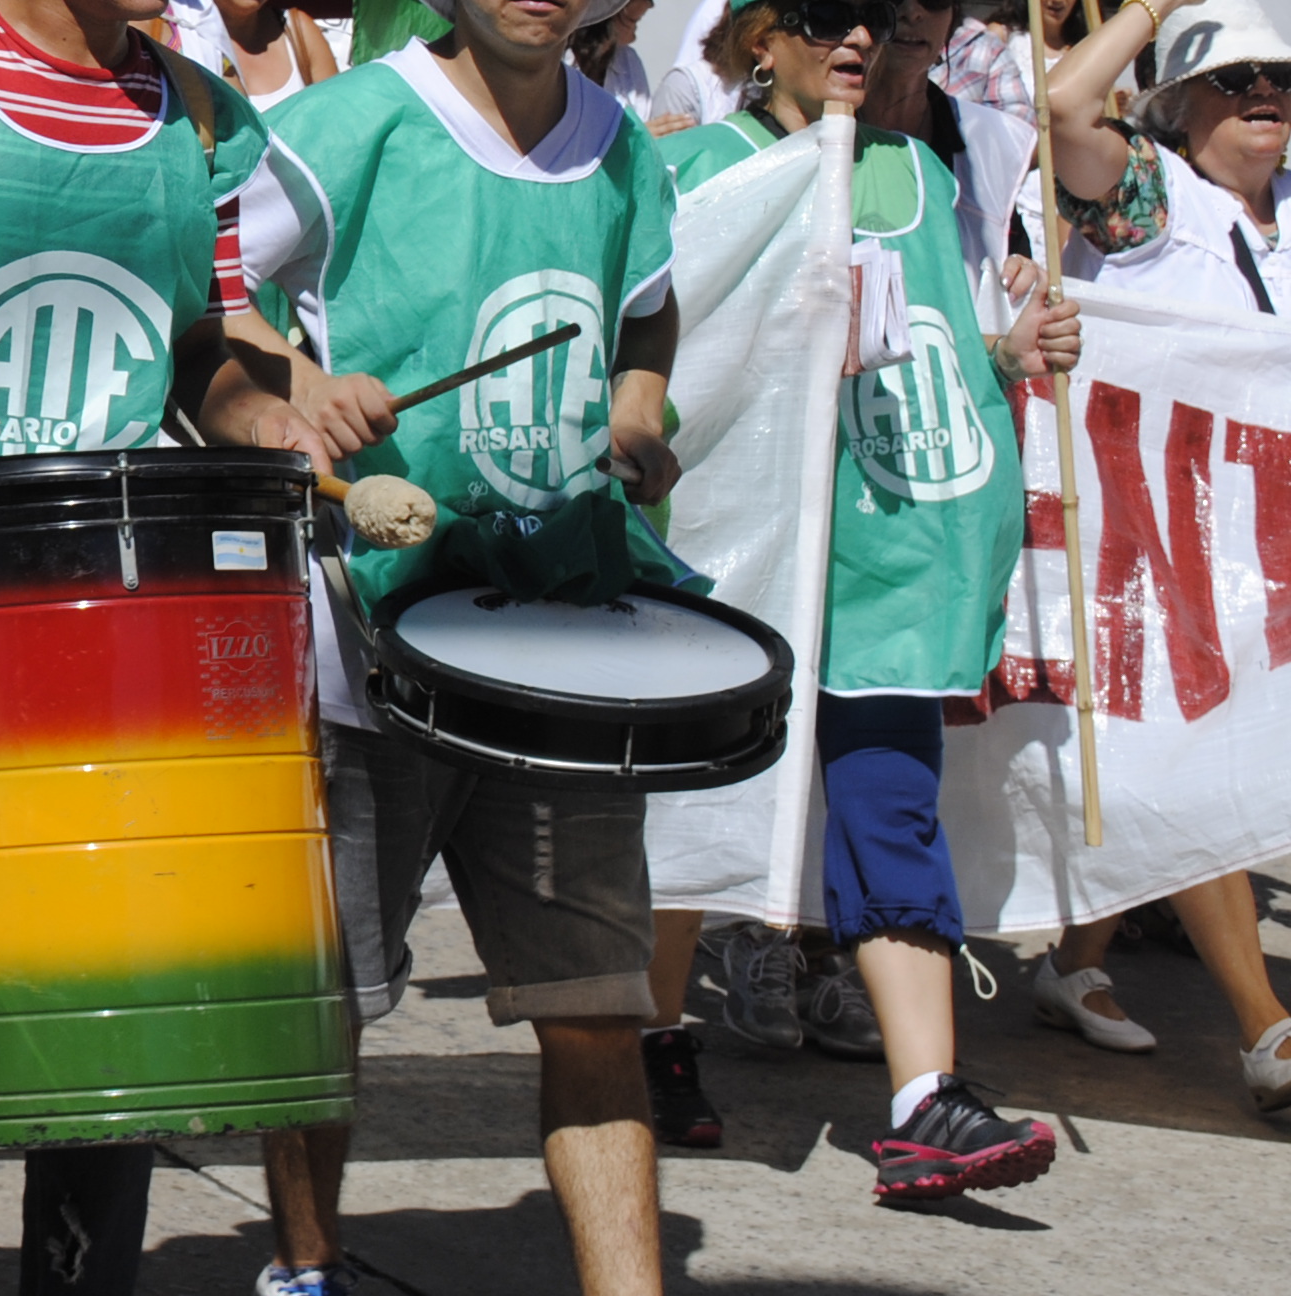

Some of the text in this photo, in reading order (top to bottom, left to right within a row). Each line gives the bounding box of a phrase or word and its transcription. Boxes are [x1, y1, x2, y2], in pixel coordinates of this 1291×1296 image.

[856, 323, 981, 481] ATE
[849, 428, 951, 460] ROSARIO
[210, 633, 269, 660] IZZO
